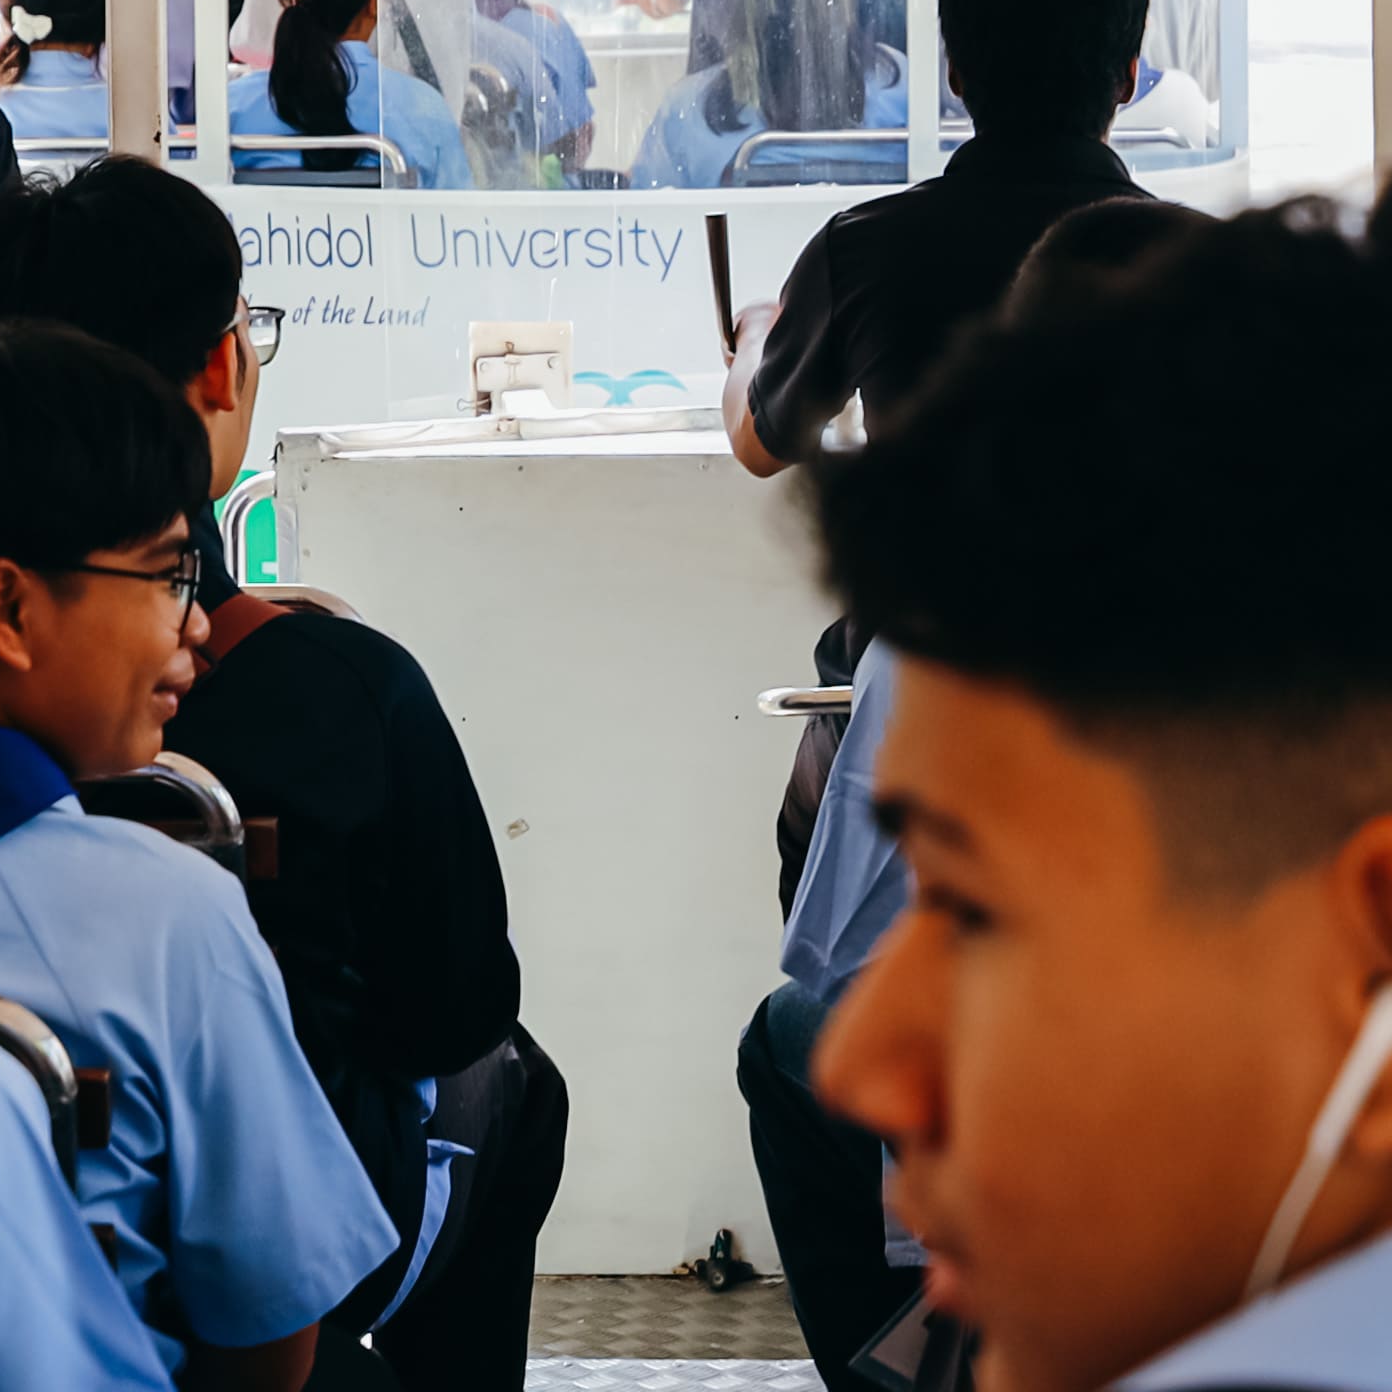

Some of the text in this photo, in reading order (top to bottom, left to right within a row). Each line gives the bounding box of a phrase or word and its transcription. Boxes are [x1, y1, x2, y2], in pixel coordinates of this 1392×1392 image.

[226, 211, 683, 282] ahidol University
[292, 295, 316, 327] of
[322, 294, 356, 325] the
[363, 295, 431, 327] Land
